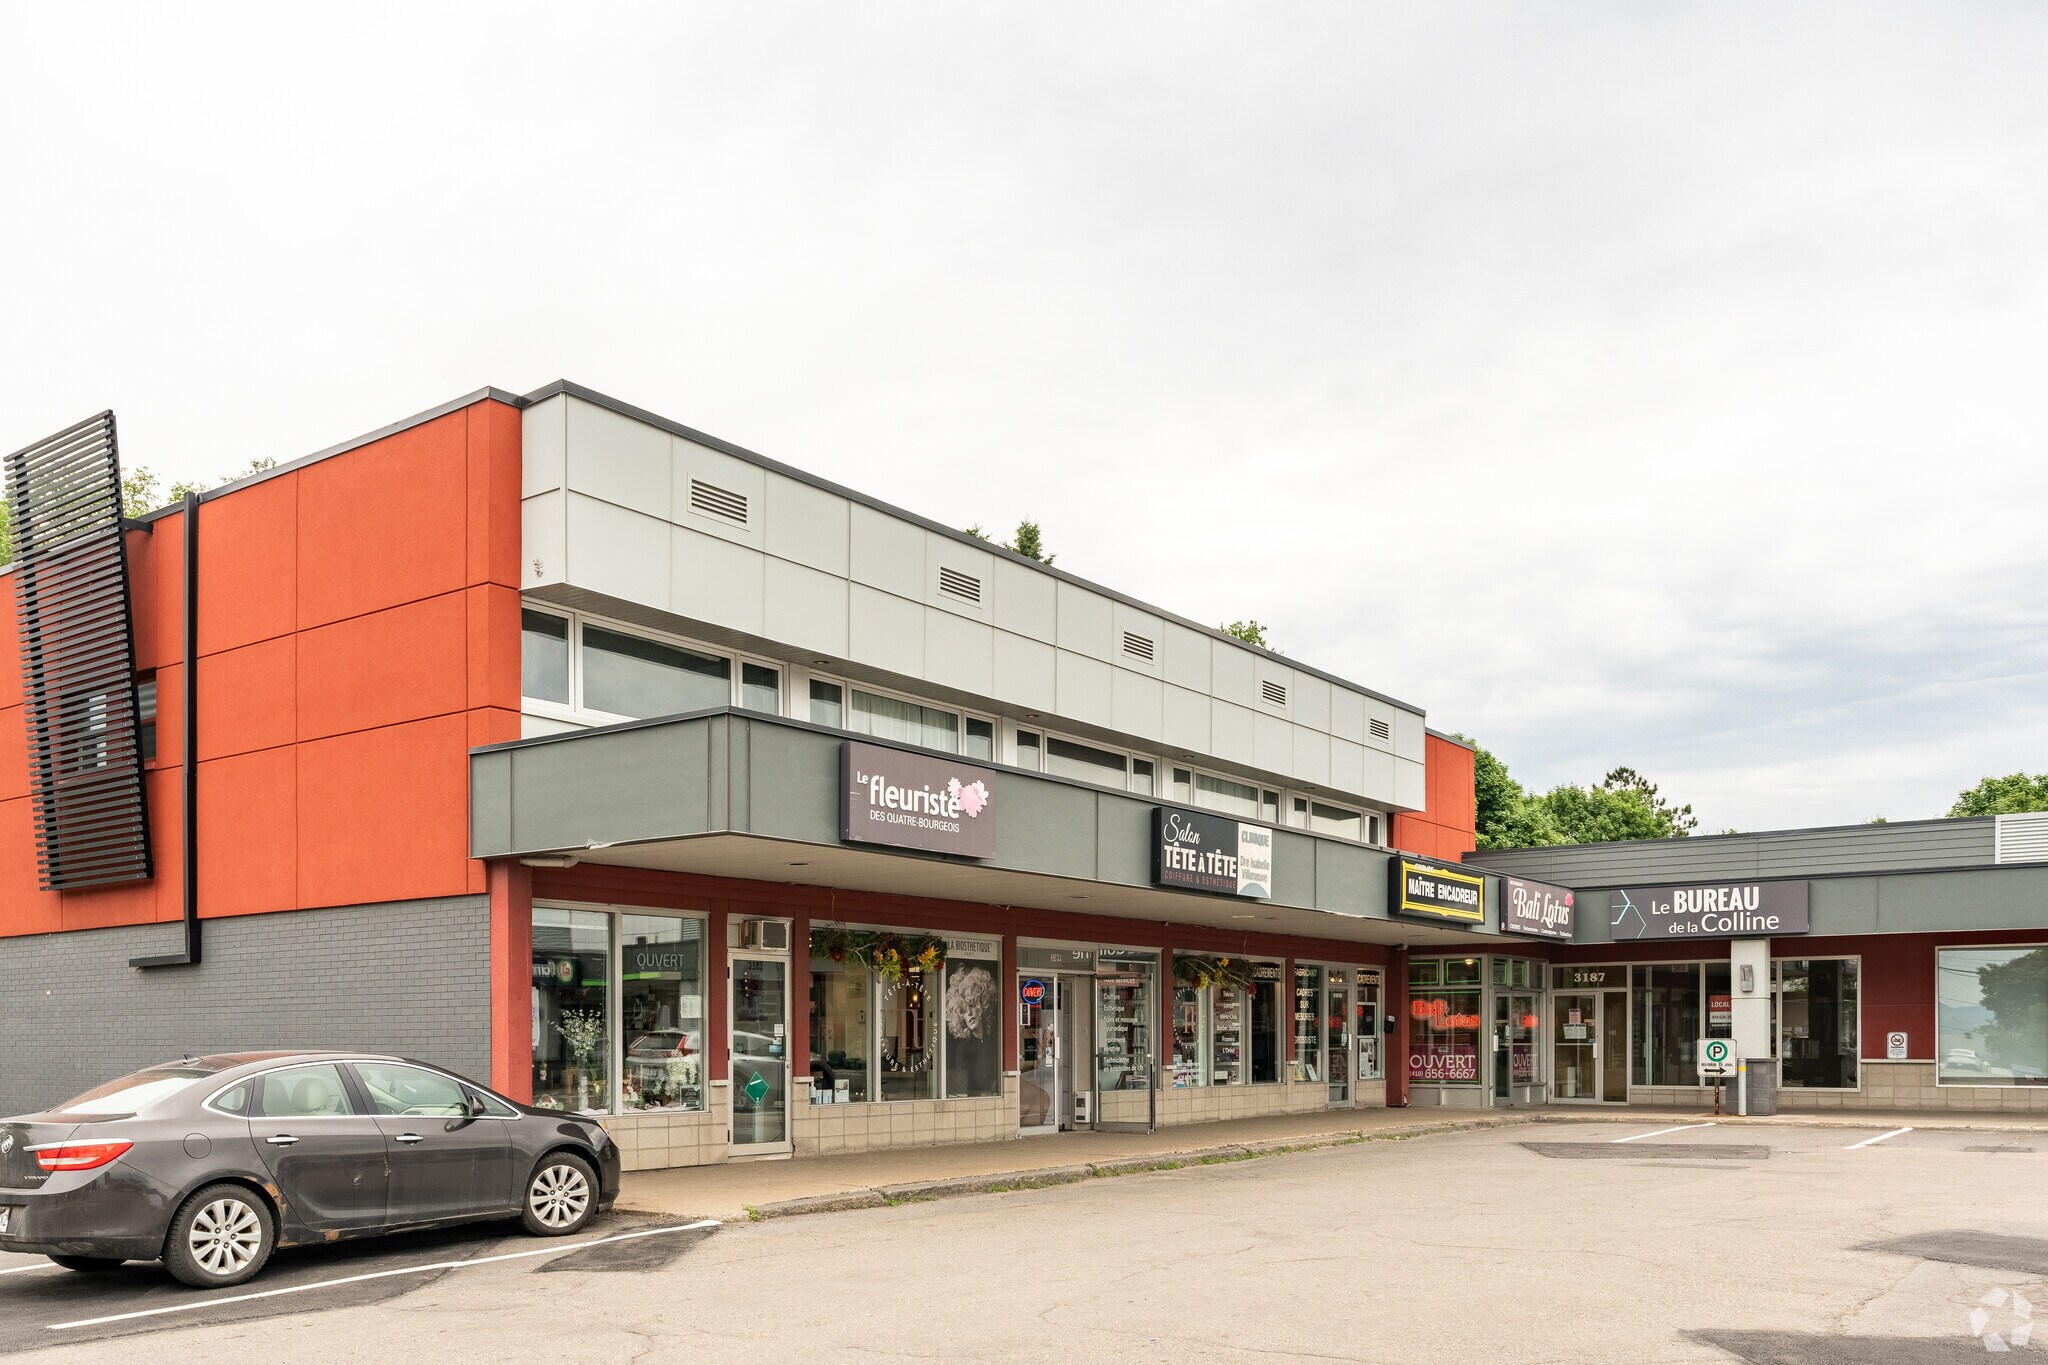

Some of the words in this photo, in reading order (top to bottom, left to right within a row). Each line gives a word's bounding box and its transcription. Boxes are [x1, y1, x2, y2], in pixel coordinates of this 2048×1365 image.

[857, 771, 868, 784] Le
[870, 775, 961, 818] fleuriste
[870, 810, 885, 821] DES
[886, 812, 960, 832] QUATRE-BOURGEOIS
[1164, 814, 1200, 844] Salon
[1242, 830, 1270, 847] CLINIQUE
[1164, 842, 1196, 872] TÊTE
[1198, 852, 1206, 873] À
[1206, 848, 1236, 878] TÊTE
[1164, 870, 1193, 882] COIFFURE
[1202, 876, 1236, 888] ESTHÉTIQUE
[1408, 876, 1434, 898] MAÎTRE
[1438, 884, 1478, 905] ENCADREUR
[1512, 888, 1540, 920] Bali
[1540, 893, 1570, 928] Lotus
[1652, 900, 1670, 915] Le
[1674, 886, 1760, 914] BUREAU
[1668, 922, 1684, 934] de
[1687, 921, 1698, 932] la
[1701, 912, 1780, 932] Colline
[948, 940, 954, 950] LA
[637, 953, 685, 968] OUVERT
[1574, 972, 1606, 982] 3187
[1023, 986, 1043, 998] OUVERT
[1296, 988, 1313, 997] CADRES
[1300, 1000, 1309, 1009] SUR
[1412, 1000, 1444, 1015] Bali
[1436, 1010, 1480, 1027] Lotus
[1712, 1046, 1722, 1057] P
[1409, 1054, 1476, 1068] OUVERT
[1425, 1068, 1476, 1079] 656-6667
